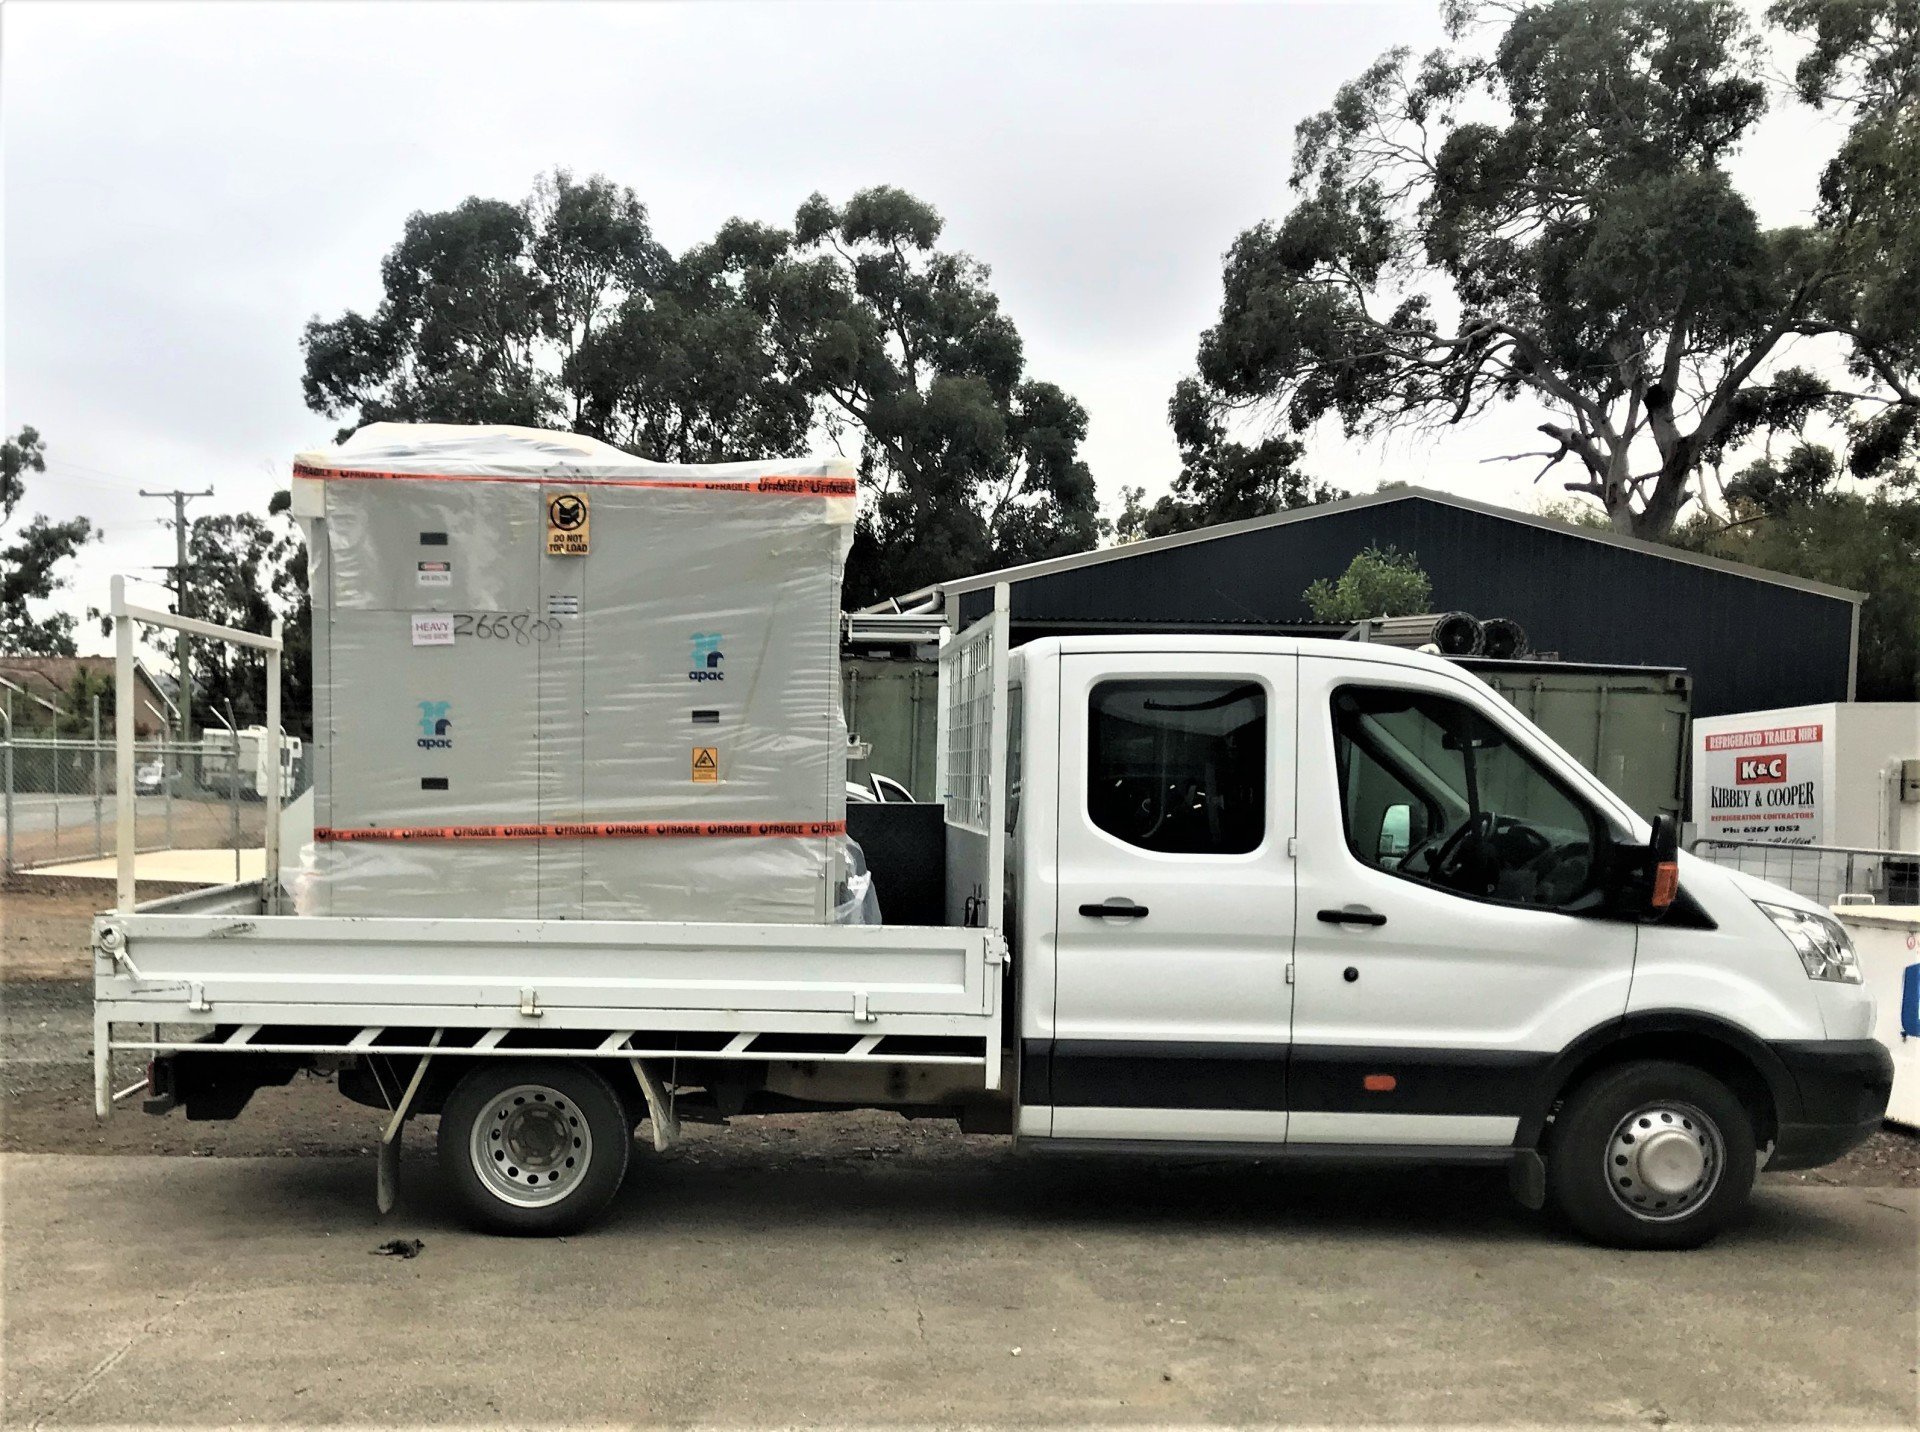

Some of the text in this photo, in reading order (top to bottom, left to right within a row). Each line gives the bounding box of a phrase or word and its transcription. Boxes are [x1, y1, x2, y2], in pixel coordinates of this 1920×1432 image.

[714, 482, 750, 492] FRAGILE
[553, 534, 583, 542] DO NOT
[549, 544, 588, 552] TOP LOAD
[416, 622, 450, 632] HEAVY
[689, 671, 724, 682] apac
[1710, 727, 1818, 749] REFRIGERATED TRAILER HIRE
[417, 738, 453, 750] apac
[1741, 759, 1782, 780] K&C
[1711, 781, 1815, 808] KIBBEY & COOPER
[1711, 812, 1815, 822] REFRIGERATION CONTRACTORS
[411, 829, 446, 839] FRAGILE
[461, 828, 497, 837] FRAGILE
[513, 826, 548, 836] FRAGILE
[563, 825, 599, 836] FRAGILE
[615, 825, 649, 835] FRAGILE
[666, 825, 700, 834] FRAGILE
[717, 825, 751, 834] FRAGILE
[769, 824, 803, 834] FRAGILE
